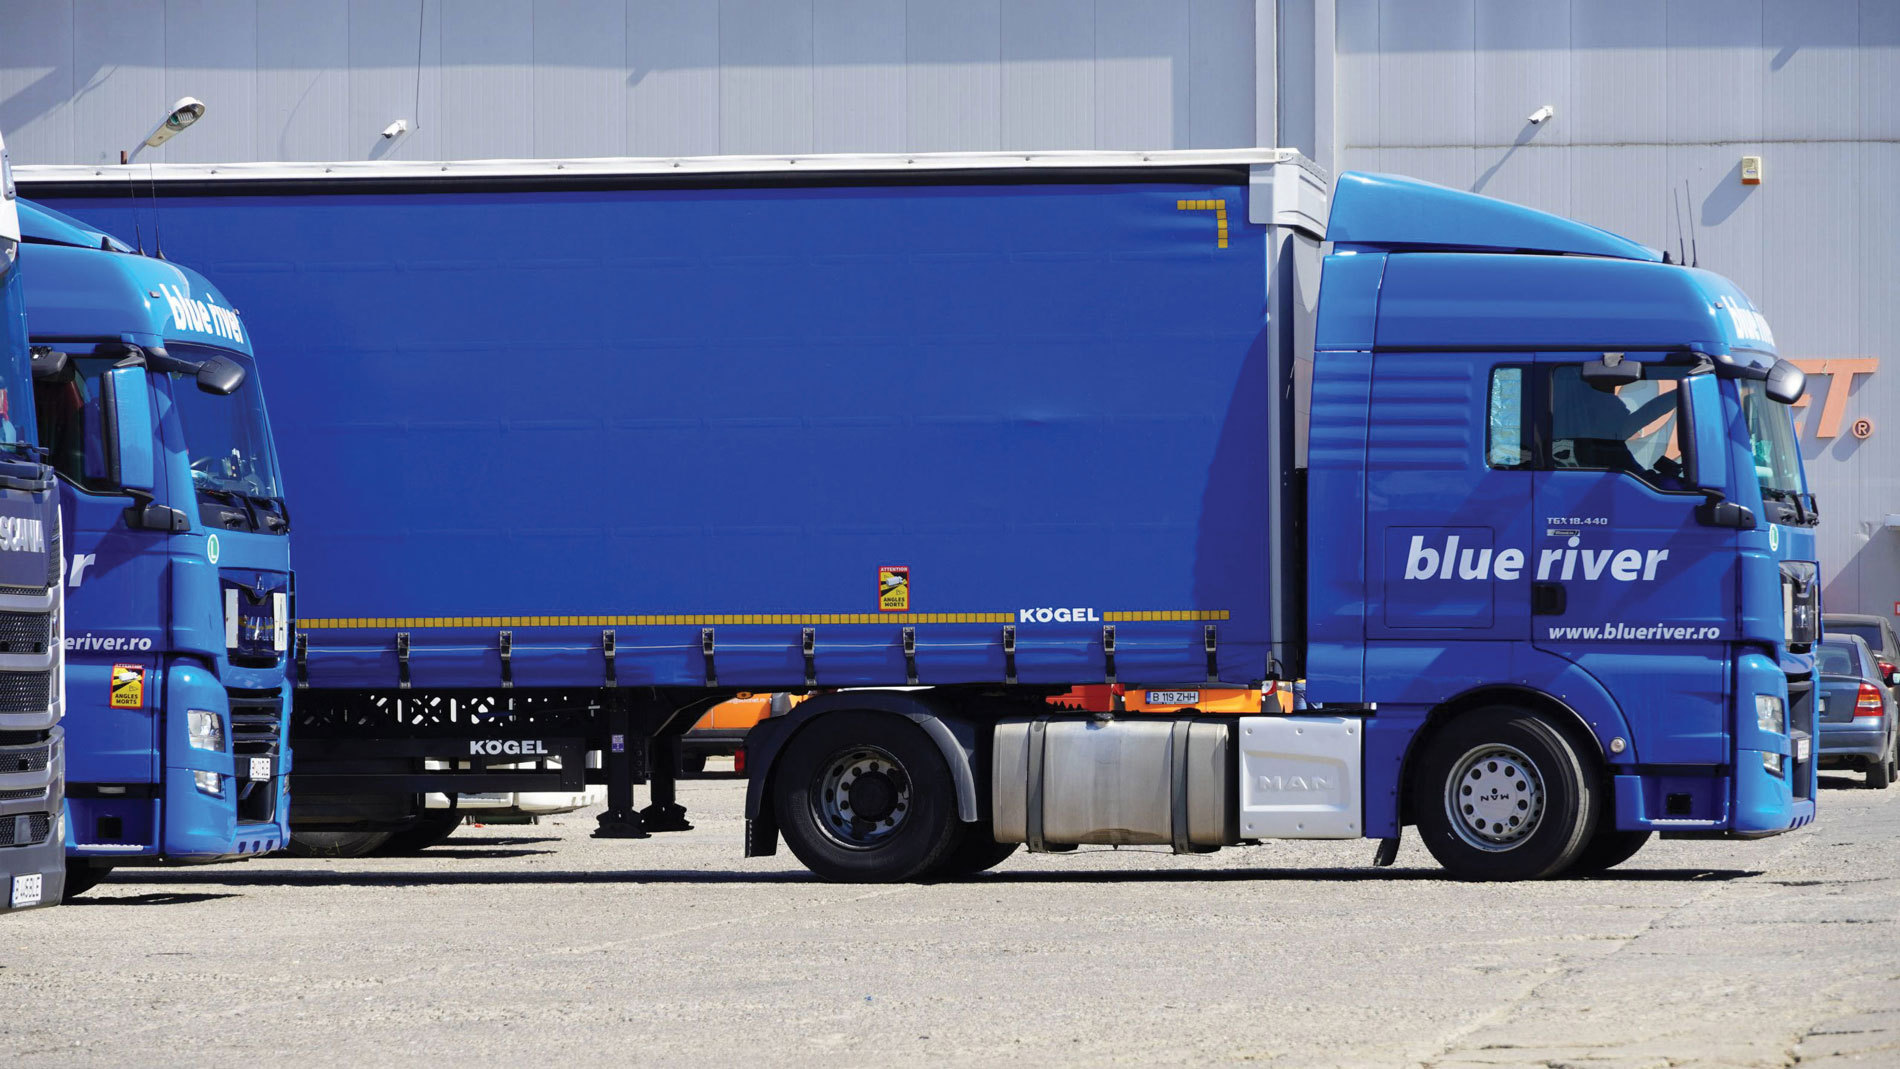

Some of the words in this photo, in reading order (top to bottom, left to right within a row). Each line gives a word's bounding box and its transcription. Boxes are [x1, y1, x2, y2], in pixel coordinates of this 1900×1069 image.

[159, 283, 213, 335] blue
[1546, 517, 1568, 525] TGX
[1569, 517, 1608, 525] 18.440
[0, 515, 45, 553] SCANIA
[1404, 535, 1525, 581] blue
[1536, 535, 1670, 581] river
[1020, 607, 1100, 623] KÖGEL
[1548, 623, 1720, 640] www.blueriver.ro
[65, 633, 152, 651] eriver.ro
[1152, 692, 1160, 701] B
[1162, 692, 1174, 701] 119
[1176, 692, 1196, 701] ZHH
[469, 739, 548, 755] KÖGEL
[1257, 774, 1334, 792] MAN
[1480, 793, 1510, 802] MAN
